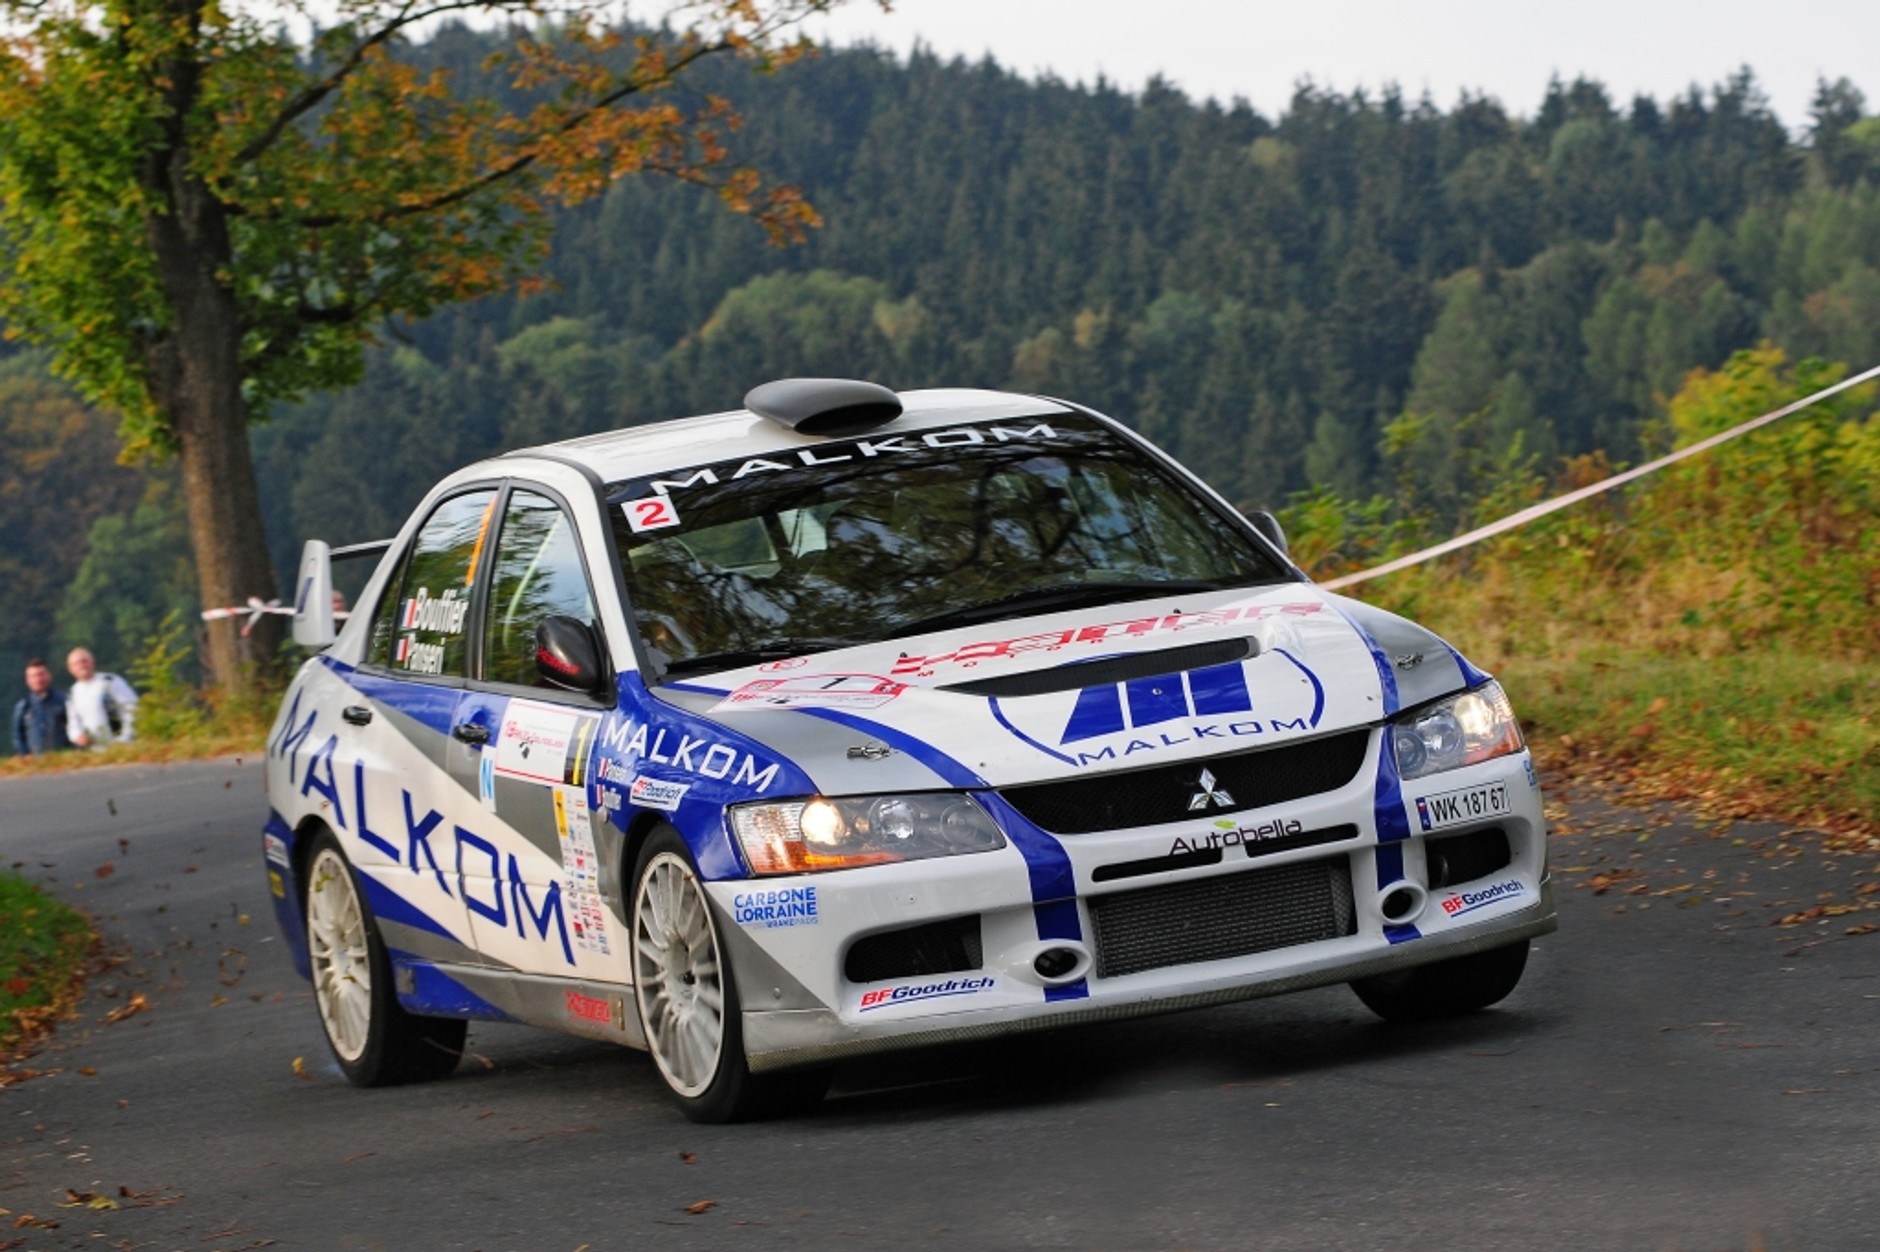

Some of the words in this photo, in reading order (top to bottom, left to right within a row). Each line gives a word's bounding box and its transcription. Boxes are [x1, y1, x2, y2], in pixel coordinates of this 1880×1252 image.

[650, 423, 1057, 495] MALKOM
[634, 500, 670, 526] 2
[820, 676, 849, 690] 1
[572, 717, 593, 785] 1
[602, 716, 780, 793] MALKOM
[1077, 717, 1307, 766] MALKOM
[1430, 796, 1461, 822] WK
[271, 687, 577, 967] MALKOM
[1168, 818, 1302, 856] Autobella
[734, 886, 816, 909] CARBONE
[736, 901, 818, 923] LORRAINE
[1441, 879, 1524, 914] BFGoodrich
[860, 976, 995, 1007] BFGoodrich
